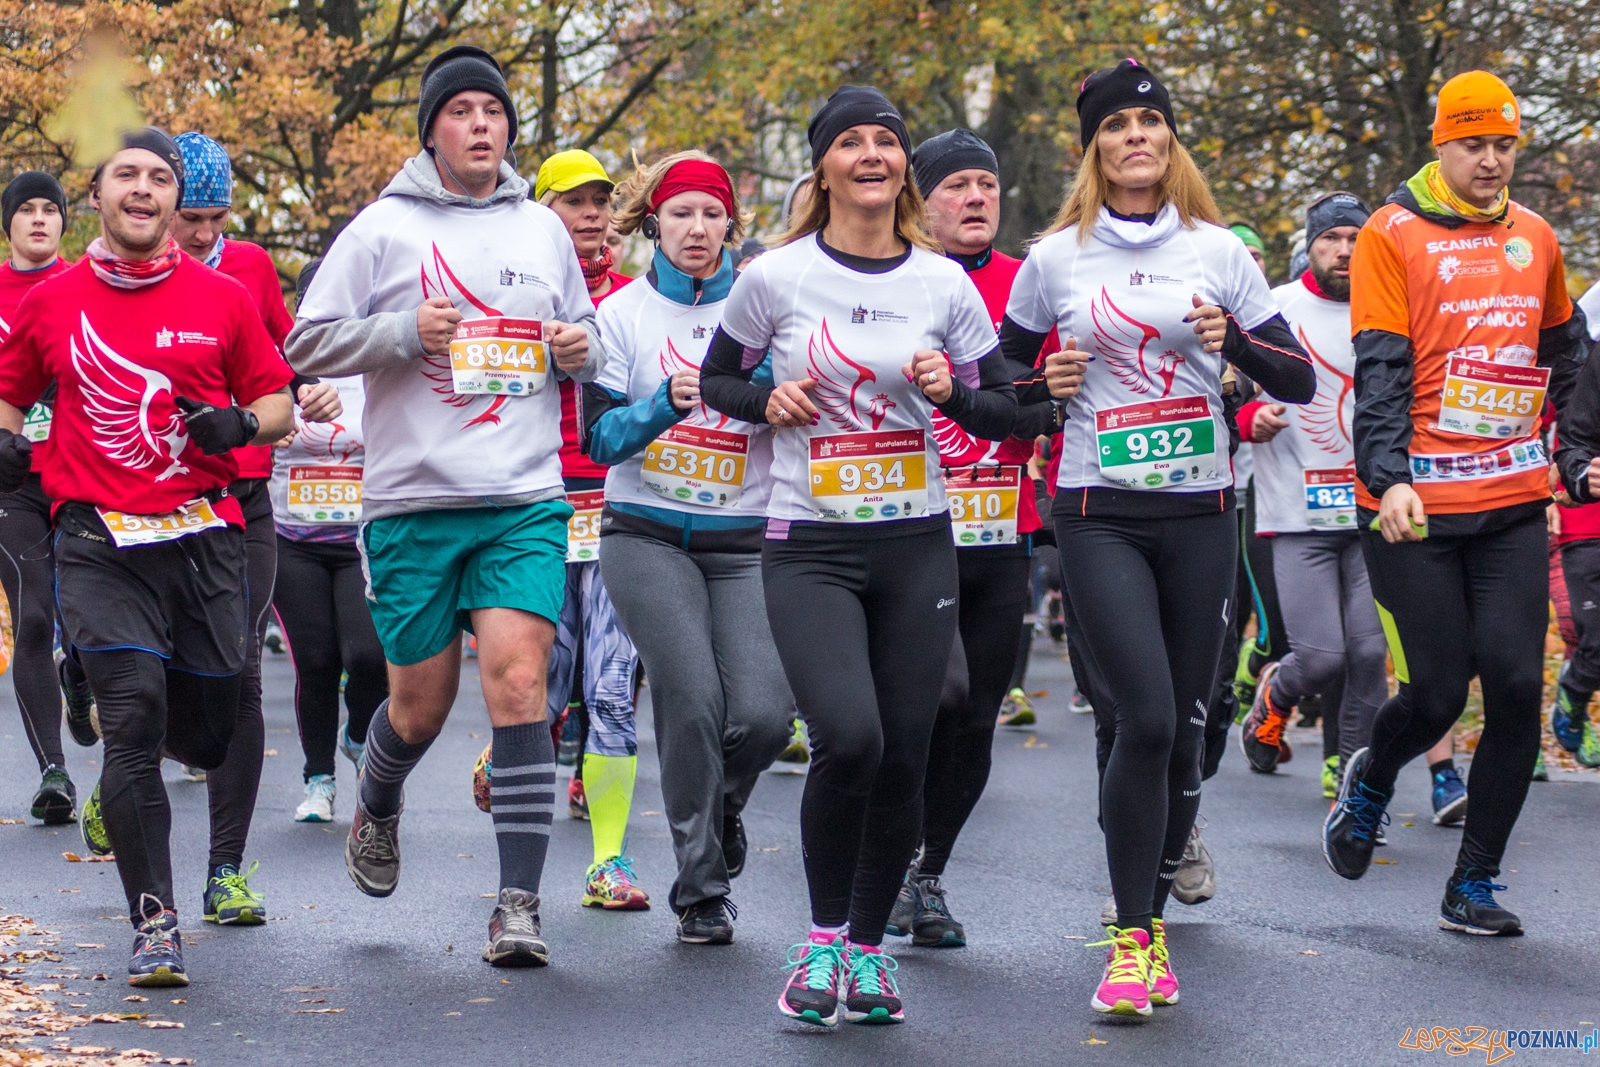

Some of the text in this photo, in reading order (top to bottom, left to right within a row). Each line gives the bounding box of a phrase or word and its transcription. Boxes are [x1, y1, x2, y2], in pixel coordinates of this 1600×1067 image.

[1426, 236, 1498, 254] SCANFIL
[1447, 264, 1499, 276] OGRODNICZE
[1439, 294, 1540, 314] POMARAŃCZOWA
[503, 326, 538, 336] RunPoland.org
[454, 343, 537, 370] D 8944
[1504, 373, 1542, 383] RunPoland.org
[1446, 384, 1535, 415] D 5445
[1160, 406, 1203, 416] RunPoland.org
[705, 437, 744, 449] RunPoland.org
[875, 440, 919, 448] RunPoland.org
[1102, 427, 1194, 460] C 932
[647, 447, 736, 482] D 5310
[685, 480, 702, 488] Maja
[813, 460, 906, 492] D 934
[299, 484, 358, 503] 8558
[121, 512, 204, 531] 5616
[567, 513, 601, 538] 58
